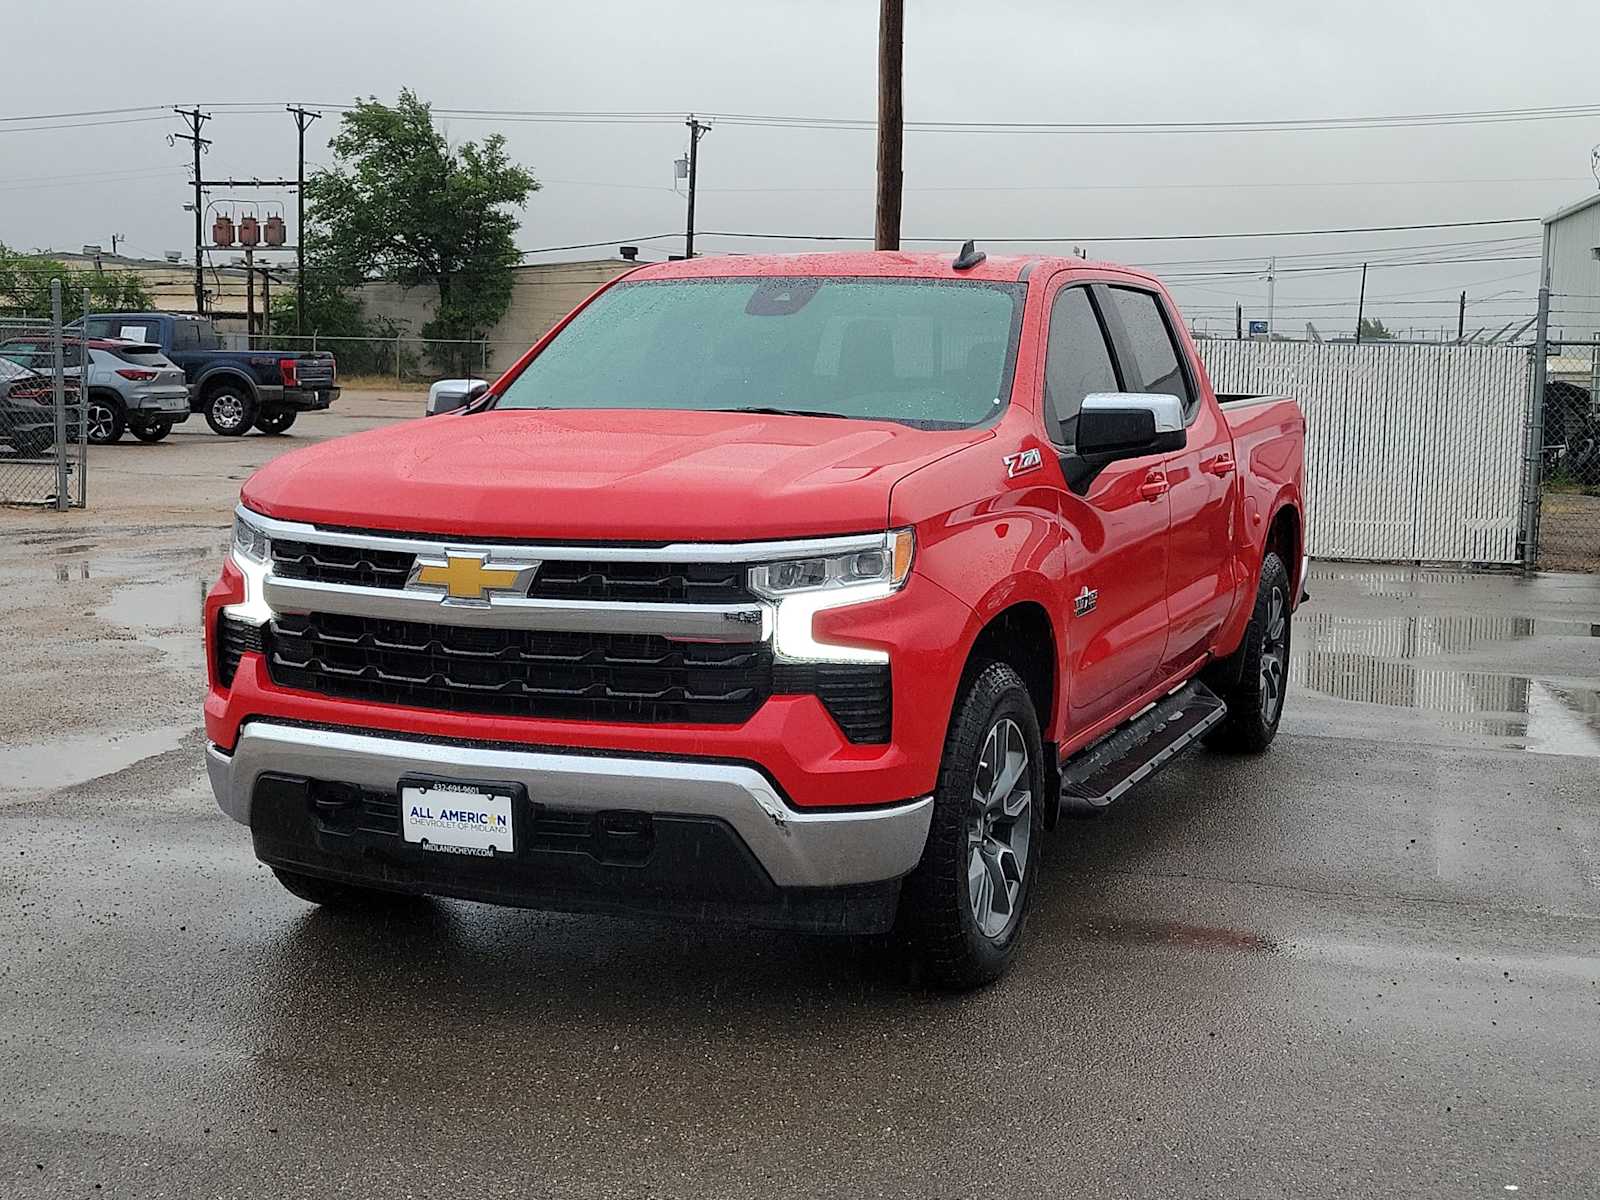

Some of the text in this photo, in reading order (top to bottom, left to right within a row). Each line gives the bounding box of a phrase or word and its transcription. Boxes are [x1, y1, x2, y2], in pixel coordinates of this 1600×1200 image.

[1002, 448, 1043, 478] Z71
[409, 817, 507, 834] CHEVROLET OF MIDLAND
[410, 806, 506, 826] ALL AMERICN
